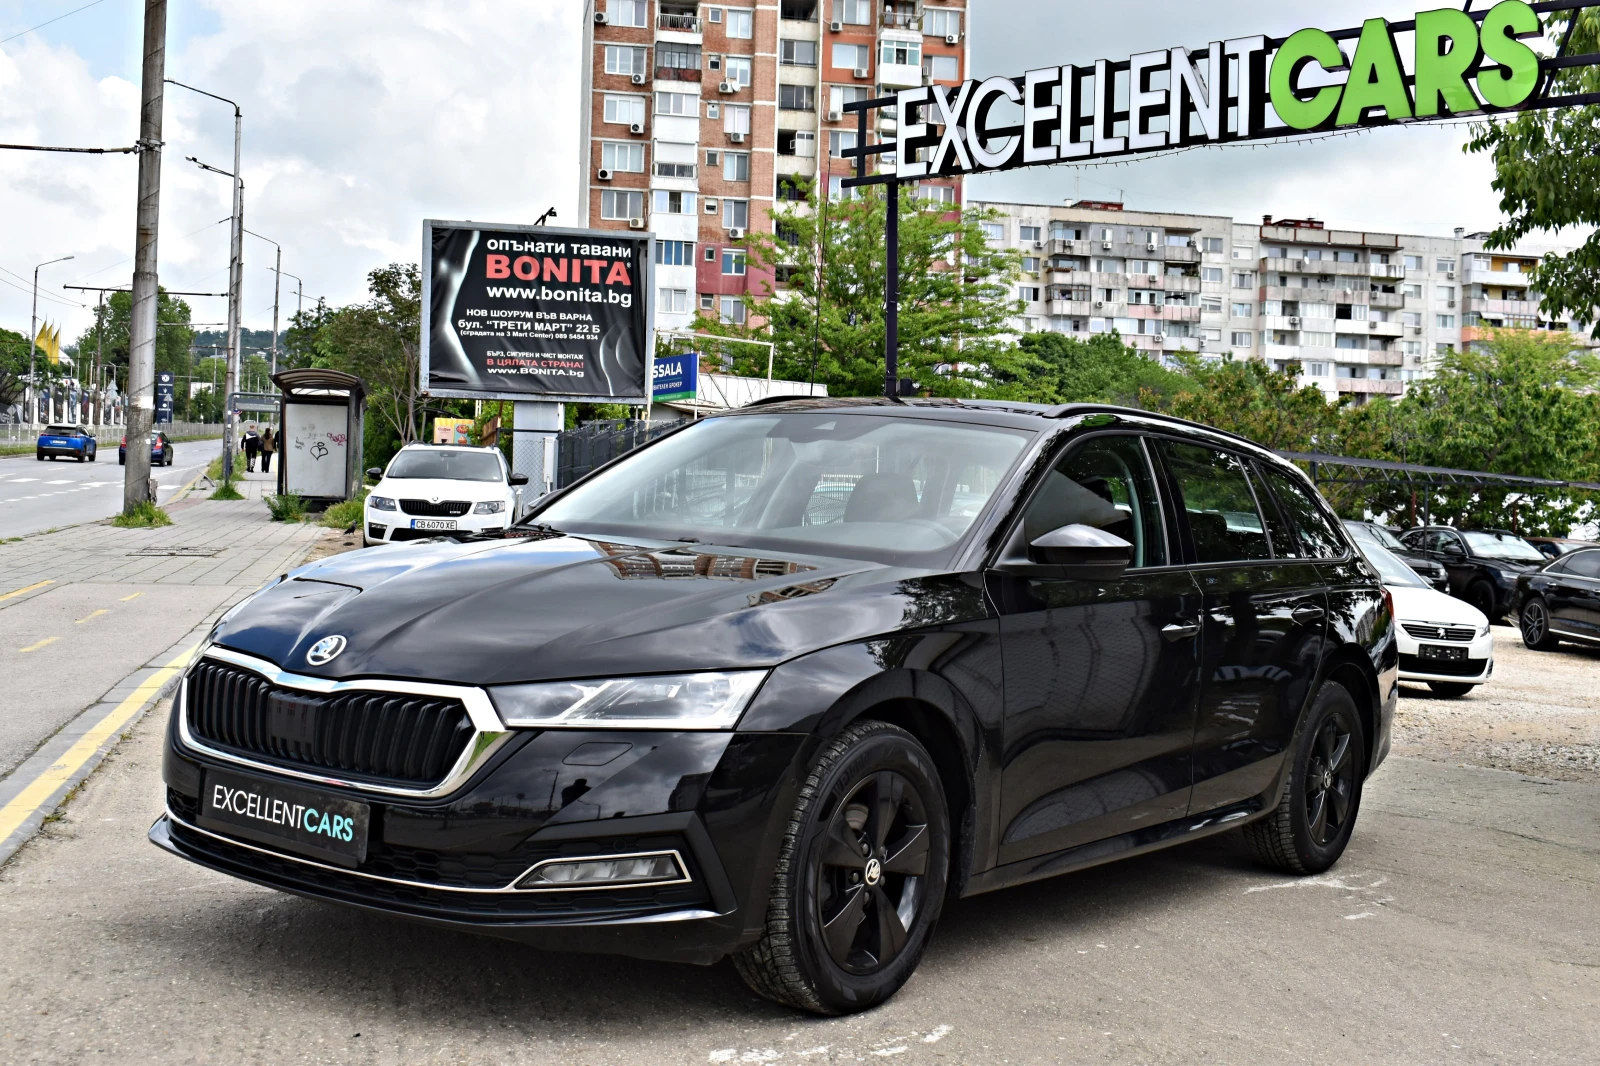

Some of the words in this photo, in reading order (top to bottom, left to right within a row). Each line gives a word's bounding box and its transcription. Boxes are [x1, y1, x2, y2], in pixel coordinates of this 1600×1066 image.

[487, 239, 565, 254] опънати
[571, 243, 631, 258] тавани
[486, 254, 631, 286] BONITA
[486, 286, 632, 308] www.bonita.bg
[466, 308, 488, 317] НОВ
[490, 309, 534, 319] ШОУРУМ
[536, 312, 557, 320] ВЪВ
[560, 312, 593, 321] ВАРНА
[458, 319, 483, 330] бул.
[576, 324, 590, 333] 22
[592, 324, 600, 334] Б
[496, 359, 538, 368] ЦЯЛАТА
[541, 361, 584, 369] СТРАНА!
[487, 368, 584, 378] www.BONITA.bg
